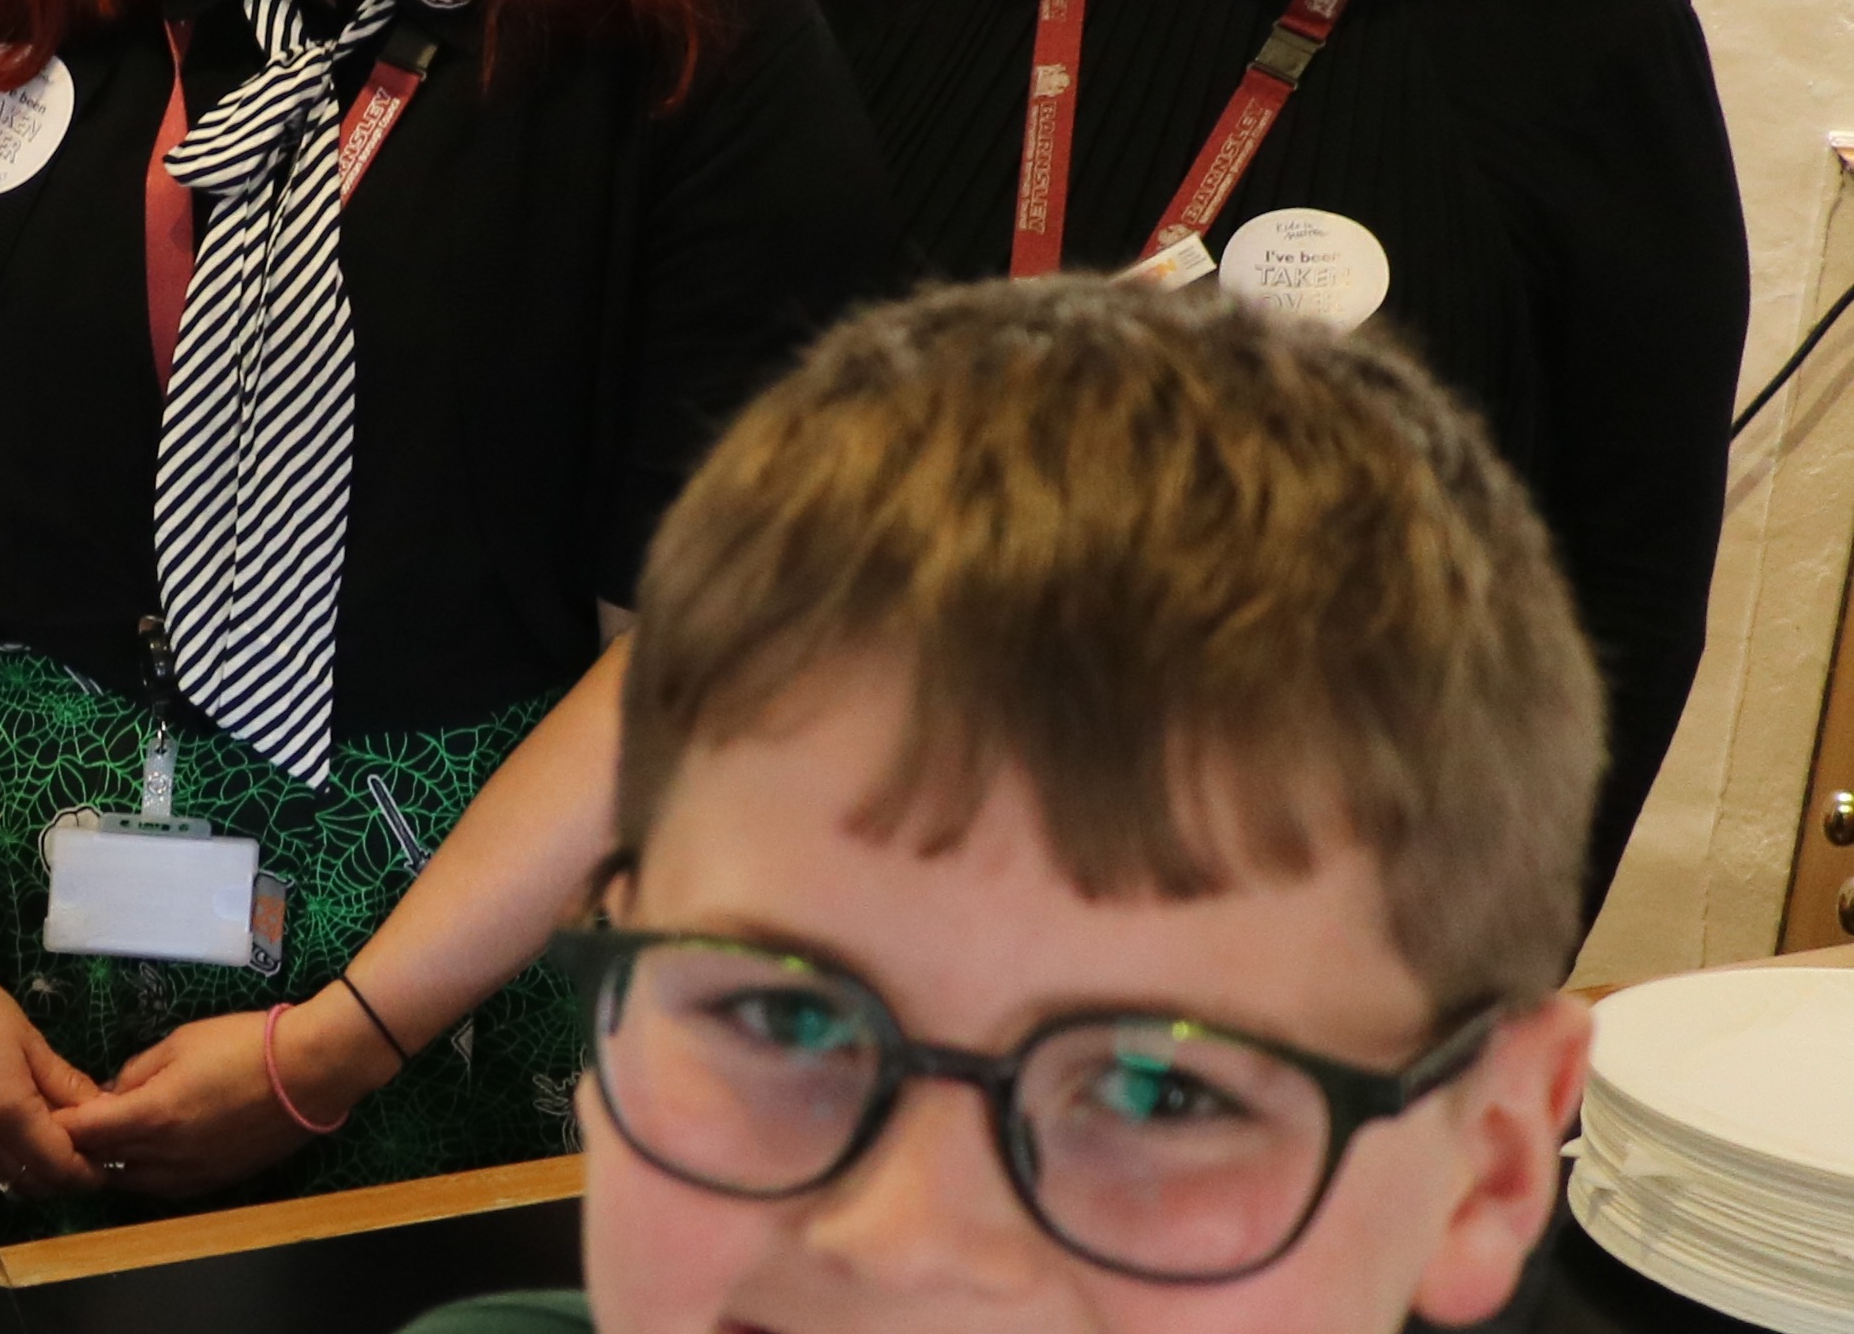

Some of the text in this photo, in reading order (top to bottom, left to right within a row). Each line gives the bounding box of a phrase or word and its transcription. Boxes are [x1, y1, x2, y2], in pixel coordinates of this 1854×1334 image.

[1029, 101, 1057, 235] BARNSLEY
[1181, 98, 1264, 224] BARNSLEY
[1265, 249, 1294, 263] I've
